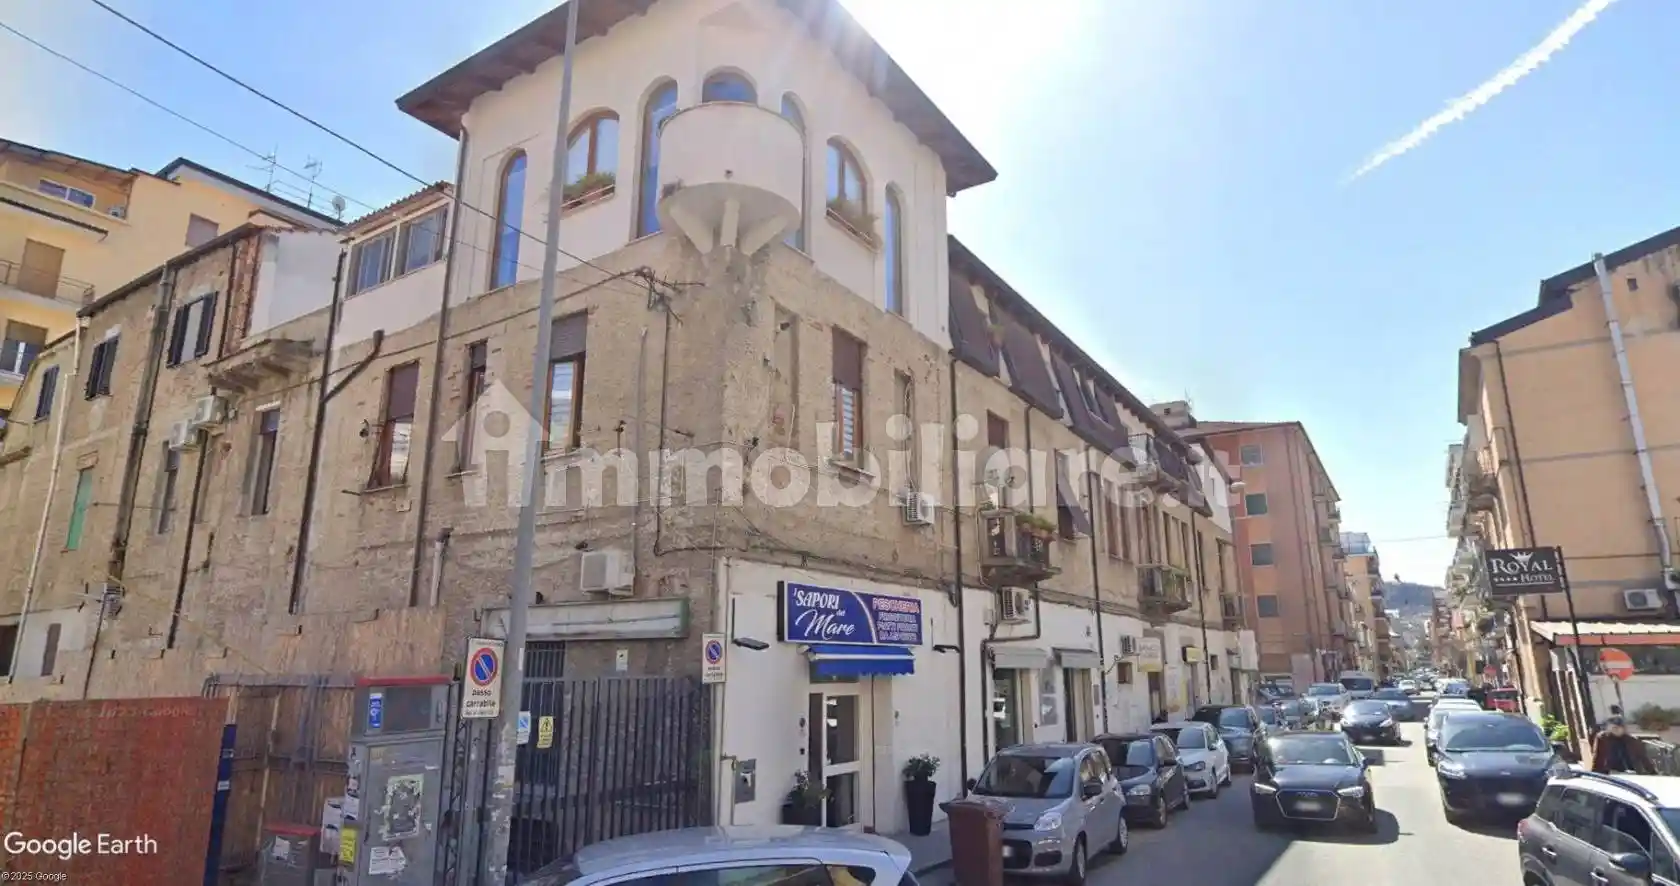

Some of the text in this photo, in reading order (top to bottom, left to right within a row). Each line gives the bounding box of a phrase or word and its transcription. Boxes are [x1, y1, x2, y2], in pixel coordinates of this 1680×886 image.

[1490, 558, 1554, 575] ROYAL
[796, 590, 840, 610] SAPORI
[795, 609, 855, 640] Mare
[472, 689, 492, 697] passo
[466, 700, 496, 708] carrabile
